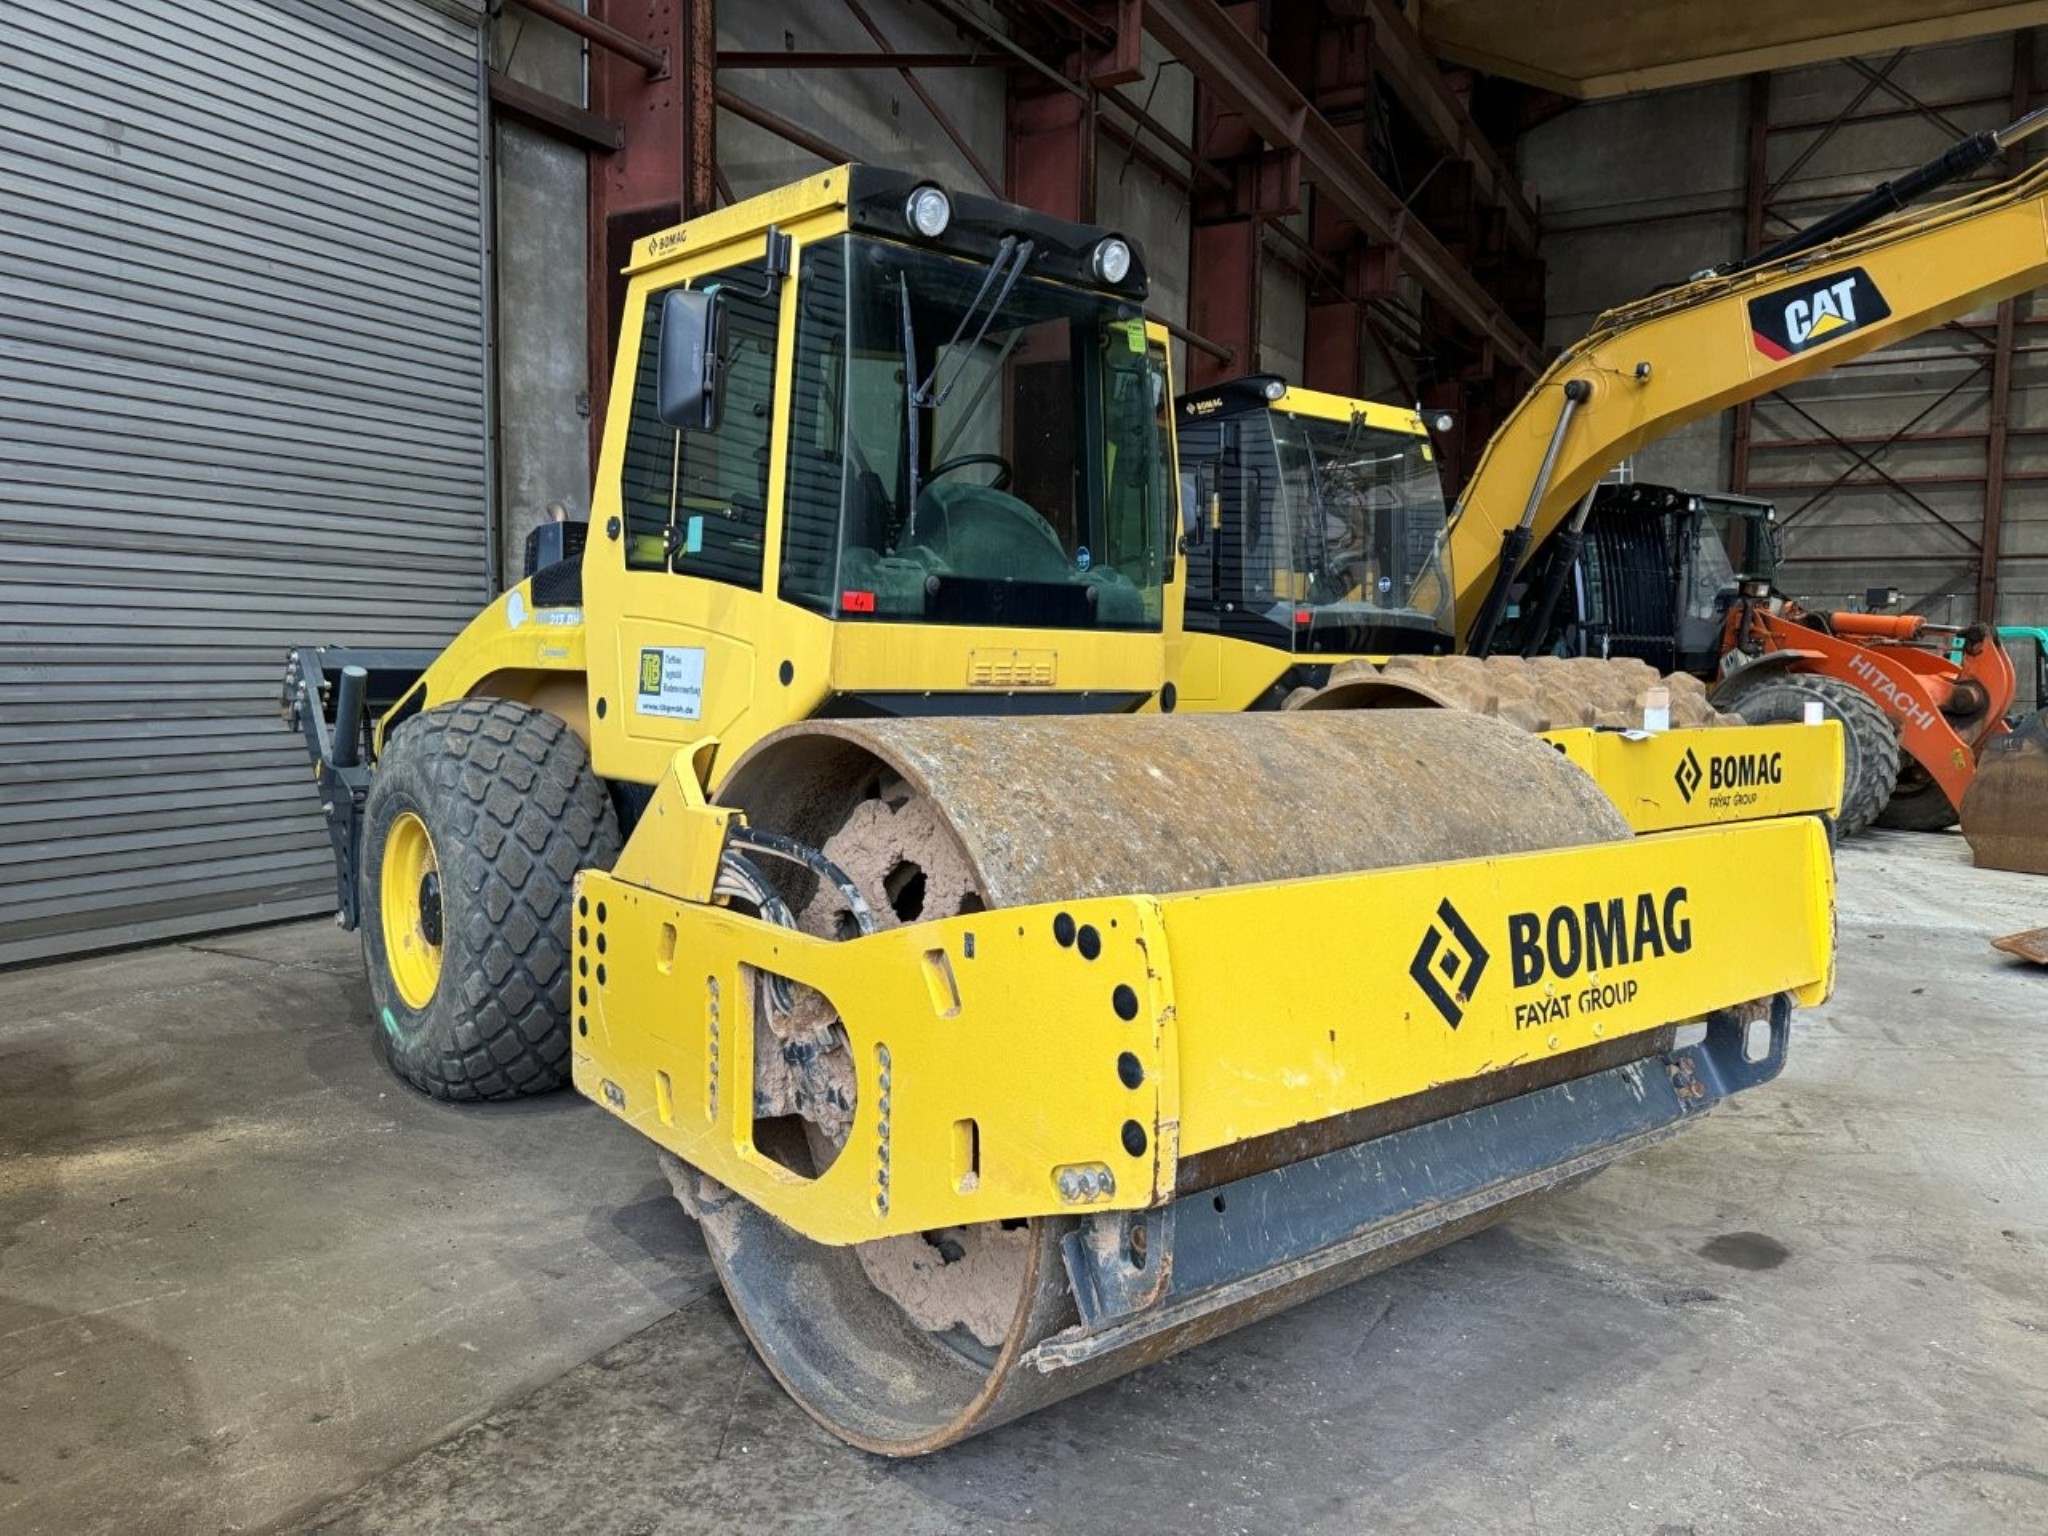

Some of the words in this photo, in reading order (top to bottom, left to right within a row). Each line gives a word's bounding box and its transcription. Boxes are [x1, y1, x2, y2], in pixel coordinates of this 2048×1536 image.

[659, 230, 687, 249] BOMAG
[1785, 277, 1856, 344] CAT
[1848, 653, 1936, 730] HITACHI
[1710, 752, 1782, 789] BOMAG
[1709, 796, 1732, 808] FAYAT
[1733, 793, 1758, 807] GROUP
[1508, 886, 1692, 989] BOMAG
[1515, 994, 1572, 1030] FAYAT
[1578, 979, 1638, 1014] GROUP
